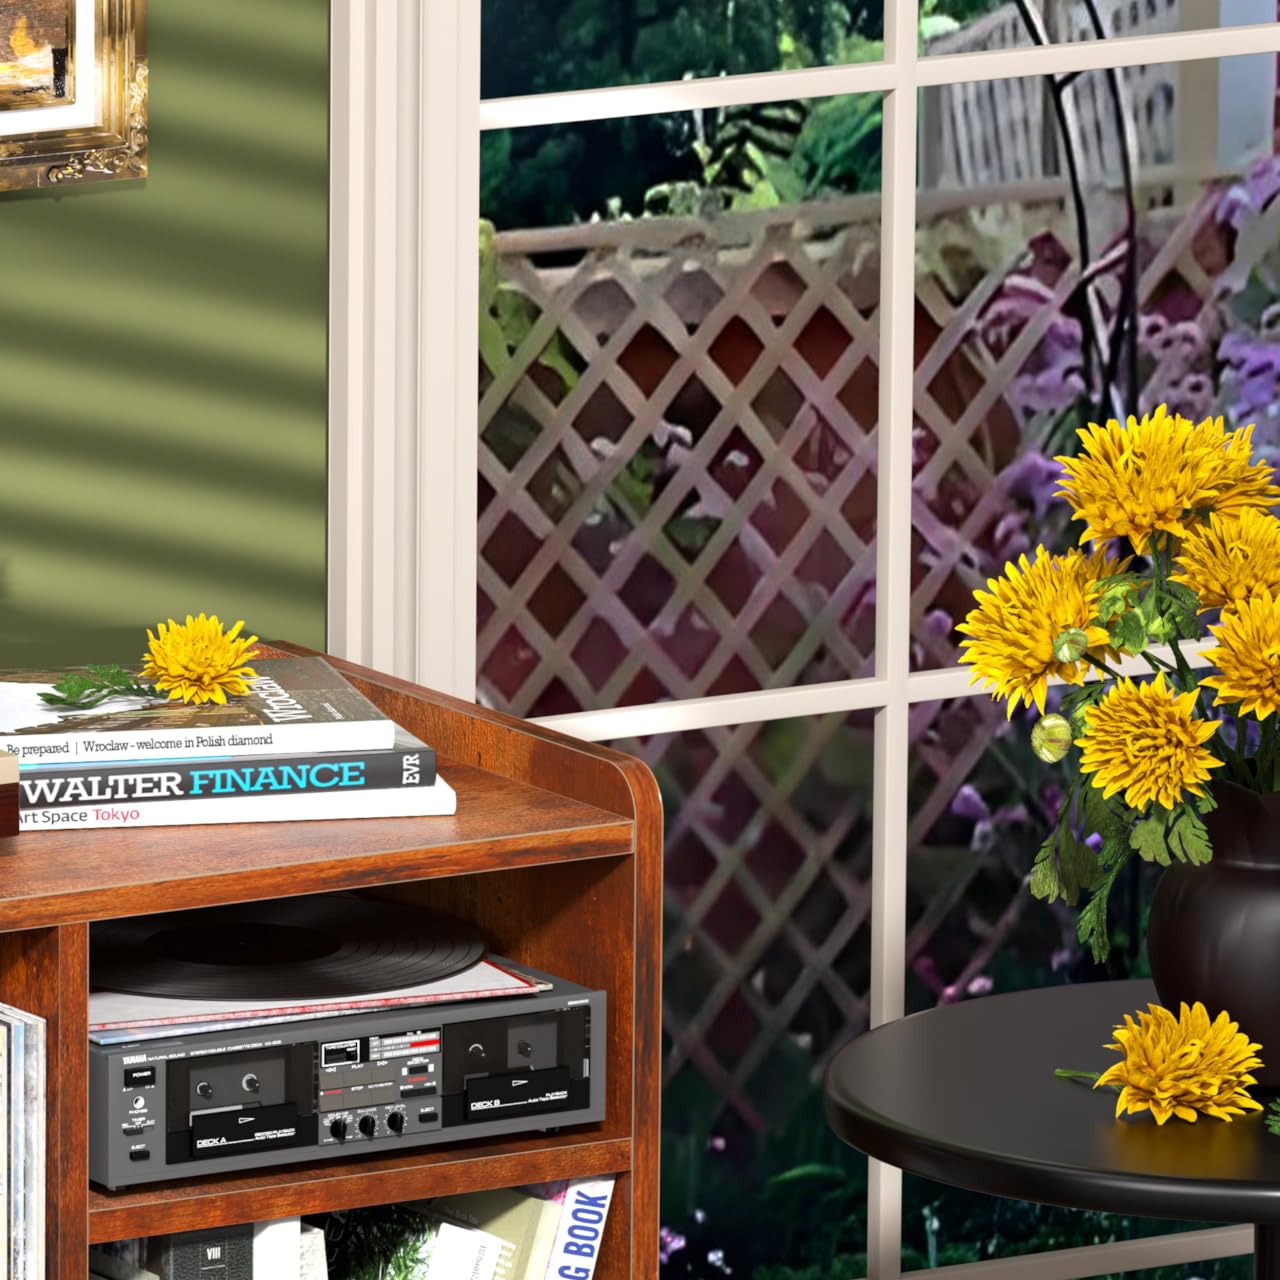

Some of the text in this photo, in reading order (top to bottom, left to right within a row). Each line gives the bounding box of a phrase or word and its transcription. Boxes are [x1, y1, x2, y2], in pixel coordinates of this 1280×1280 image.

[20, 742, 70, 757] prepared
[83, 740, 129, 752] Wroclaw
[135, 738, 183, 751] welcome
[184, 736, 195, 748] in
[196, 733, 226, 748] Polish
[227, 733, 273, 747] diamond
[402, 753, 420, 785] EVR
[20, 761, 366, 804] WALTER FINANCE
[41, 810, 88, 825] Space
[92, 808, 140, 823] Tokyo
[470, 1100, 493, 1111] DECK
[196, 1138, 220, 1148] DECK
[563, 1189, 609, 1259] BOOK
